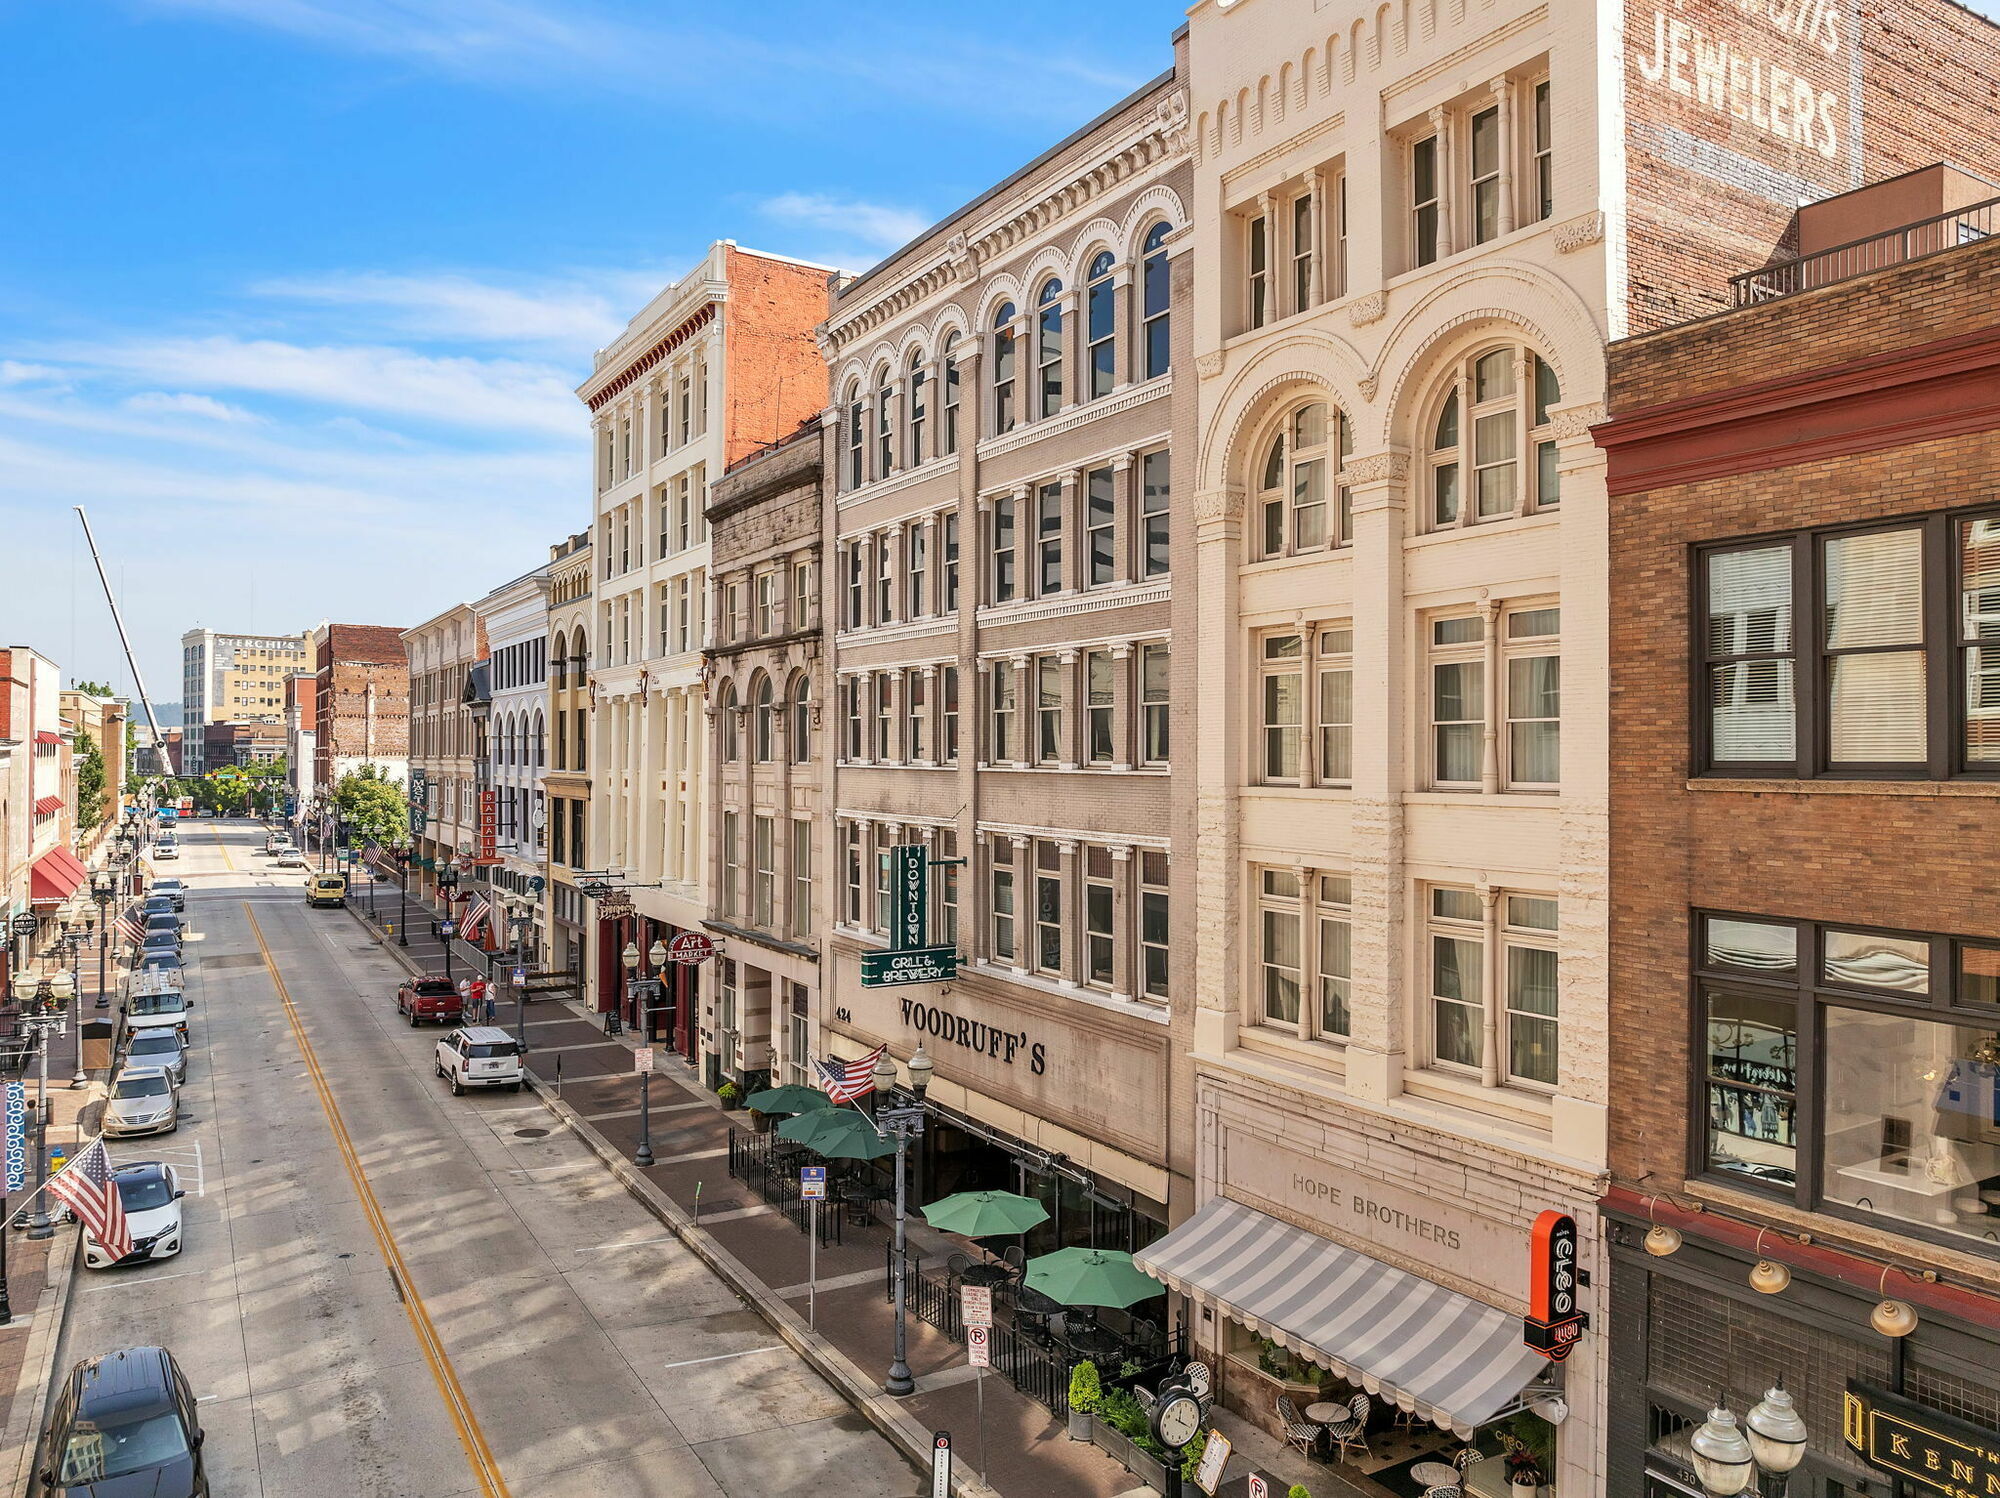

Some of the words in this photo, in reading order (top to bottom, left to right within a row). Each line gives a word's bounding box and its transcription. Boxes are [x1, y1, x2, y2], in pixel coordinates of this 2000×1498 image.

[1637, 11, 1838, 158] JEWELERS
[218, 638, 295, 650] STERCHI'S
[413, 780, 425, 803] MAST
[486, 793, 494, 857] BABALU
[907, 857, 920, 945] DOWNTOWN
[681, 936, 703, 949] Art
[676, 950, 708, 958] MARKET
[891, 956, 923, 970] GRILL
[882, 967, 945, 982] BREWERY
[836, 1006, 852, 1023] 424
[1293, 1173, 1341, 1207] HOPE
[1353, 1195, 1461, 1250] BROTHERS
